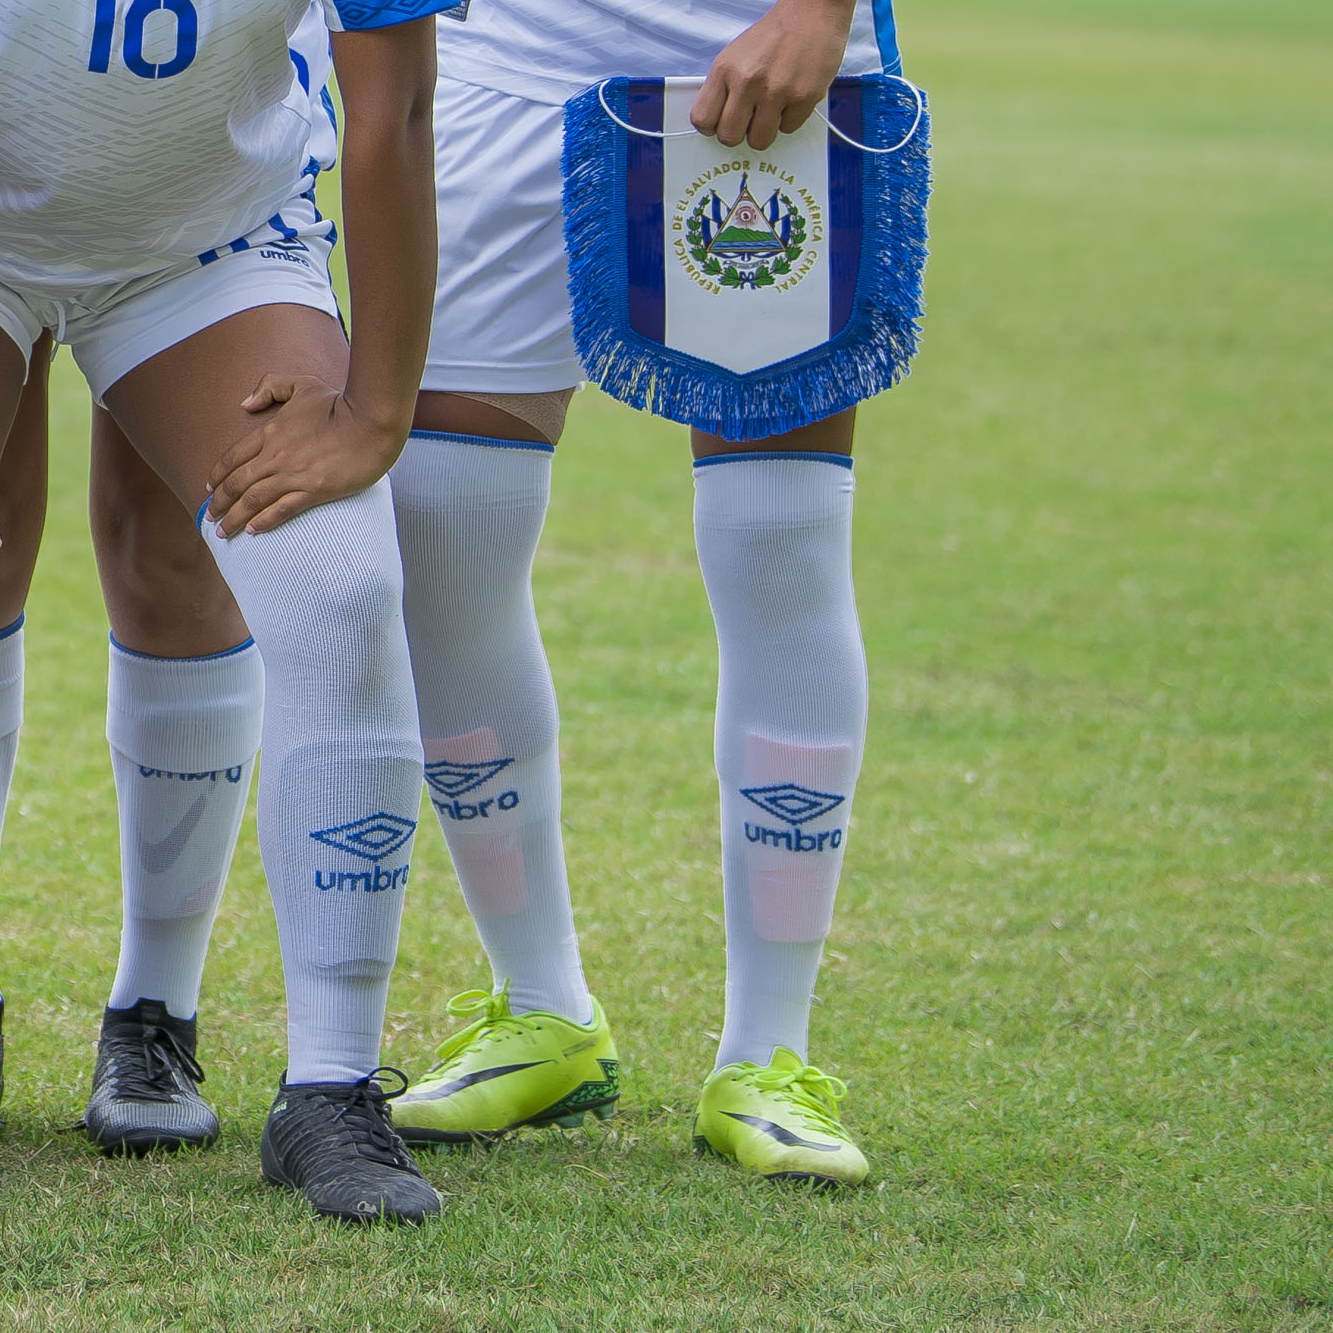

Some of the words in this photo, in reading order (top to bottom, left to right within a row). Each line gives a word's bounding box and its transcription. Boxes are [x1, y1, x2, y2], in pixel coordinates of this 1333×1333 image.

[685, 161, 751, 197] SALVADOR
[758, 162, 778, 175] EN
[780, 170, 795, 185] LA
[673, 216, 683, 231] DE
[797, 188, 823, 243] AMÉRICA
[260, 250, 310, 268] umbro
[674, 238, 722, 295] REPÚBLICA
[744, 820, 841, 852] umbro
[315, 864, 409, 892] umbro
